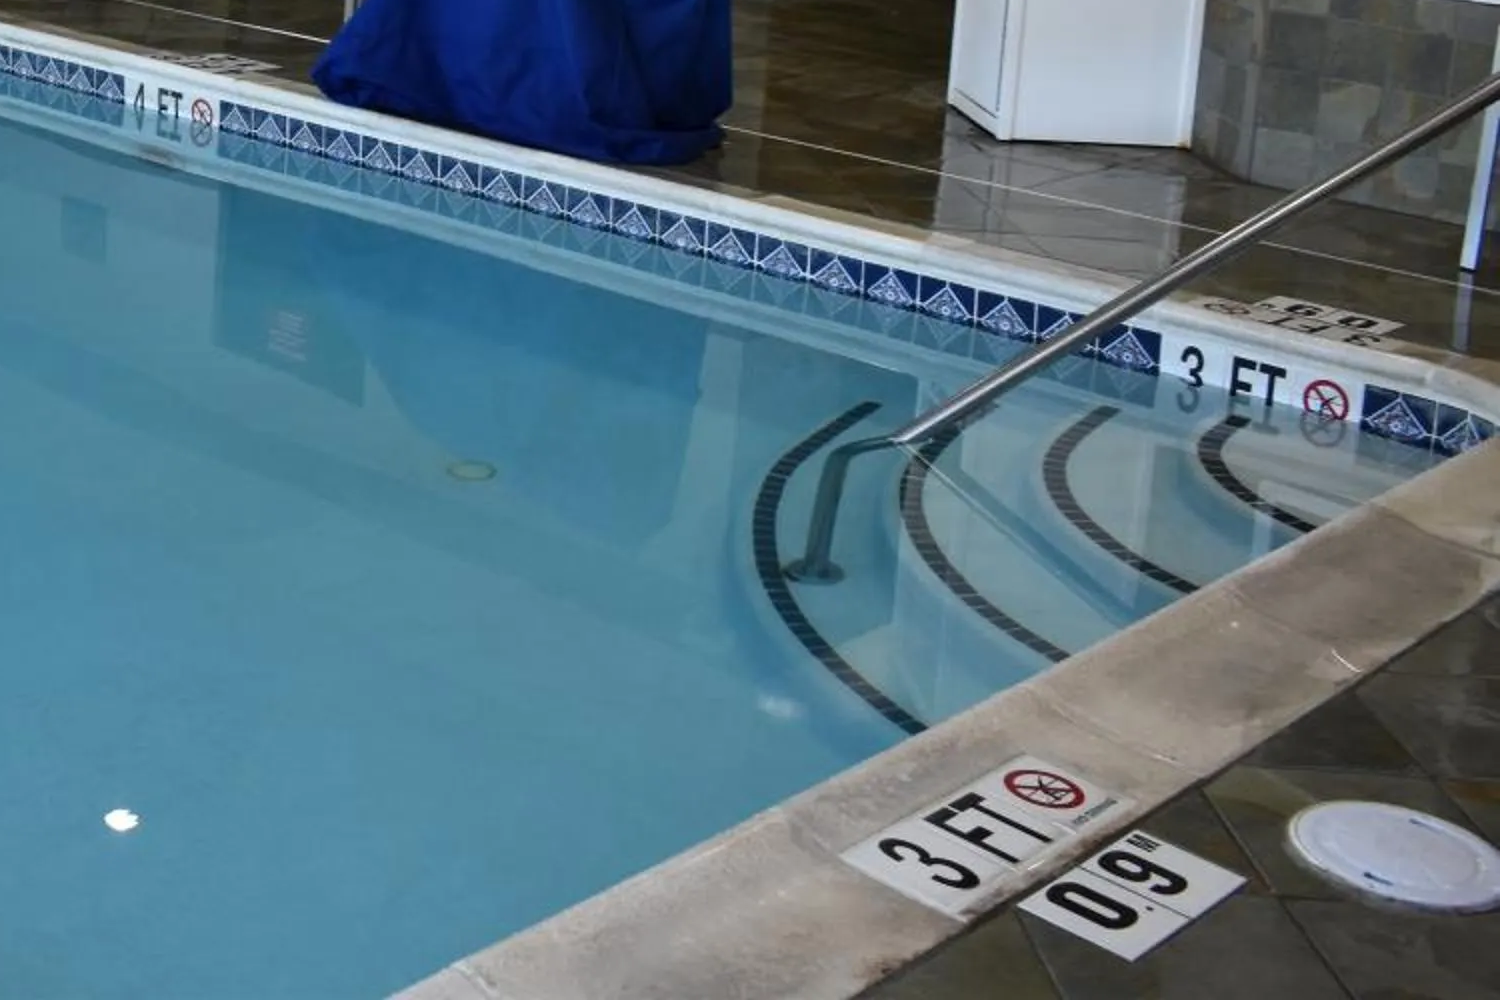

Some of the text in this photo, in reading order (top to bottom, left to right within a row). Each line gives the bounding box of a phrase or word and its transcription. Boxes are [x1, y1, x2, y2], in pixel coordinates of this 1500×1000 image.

[157, 88, 184, 119] FT
[1180, 345, 1287, 407] 3 FT
[878, 791, 1055, 890] 3 FT
[1045, 849, 1189, 930] 0.9
